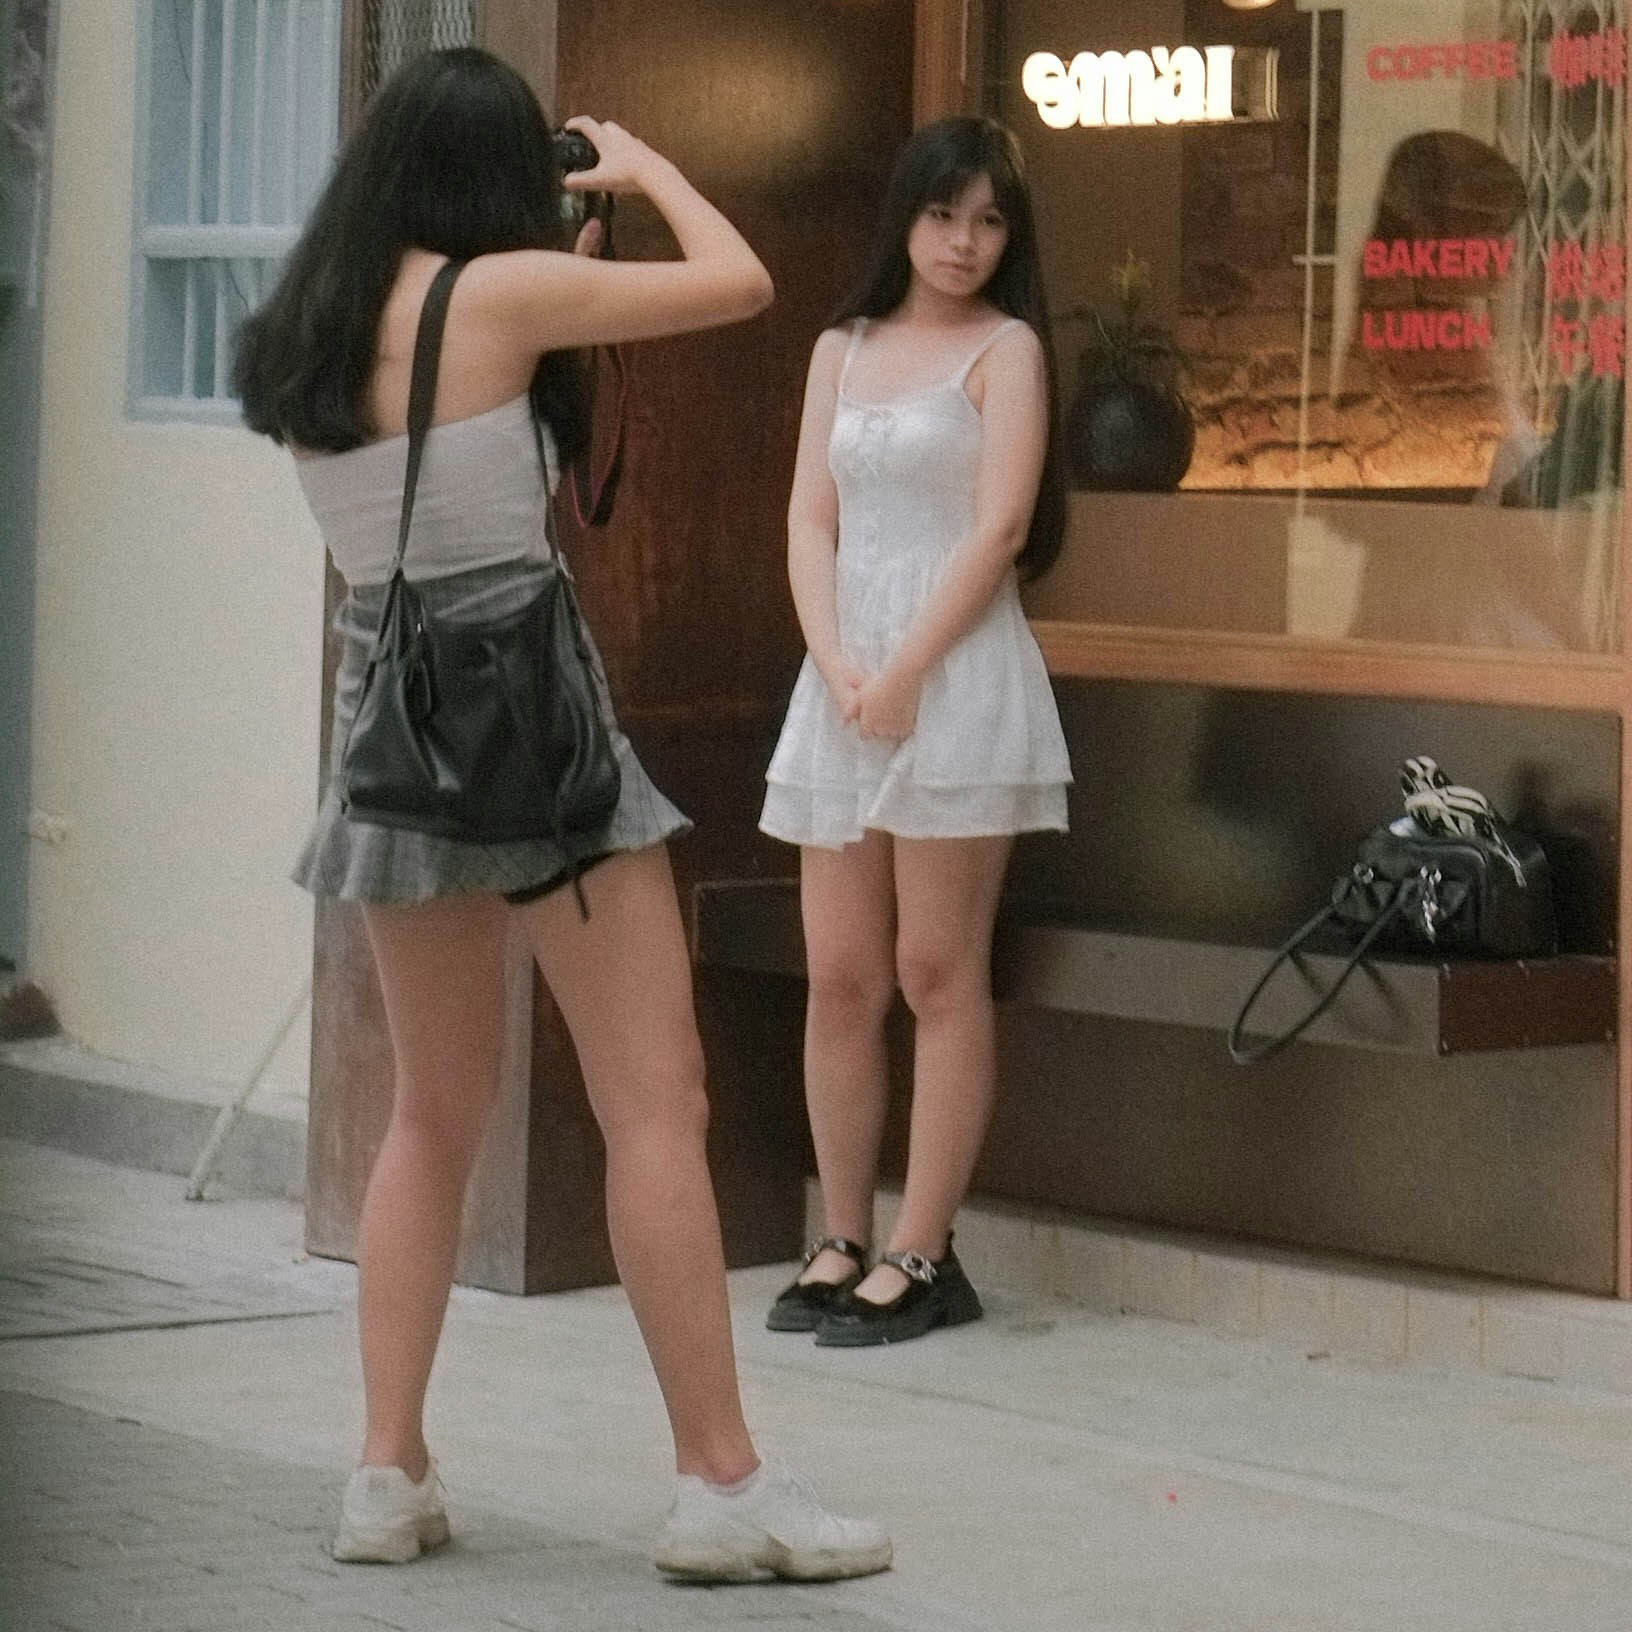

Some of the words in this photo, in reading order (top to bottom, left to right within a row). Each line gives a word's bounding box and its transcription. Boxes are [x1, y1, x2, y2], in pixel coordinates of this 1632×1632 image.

[1366, 41, 1519, 82] COFFEE
[1363, 238, 1516, 277] BAKERY
[1362, 310, 1492, 349] LUNCH
